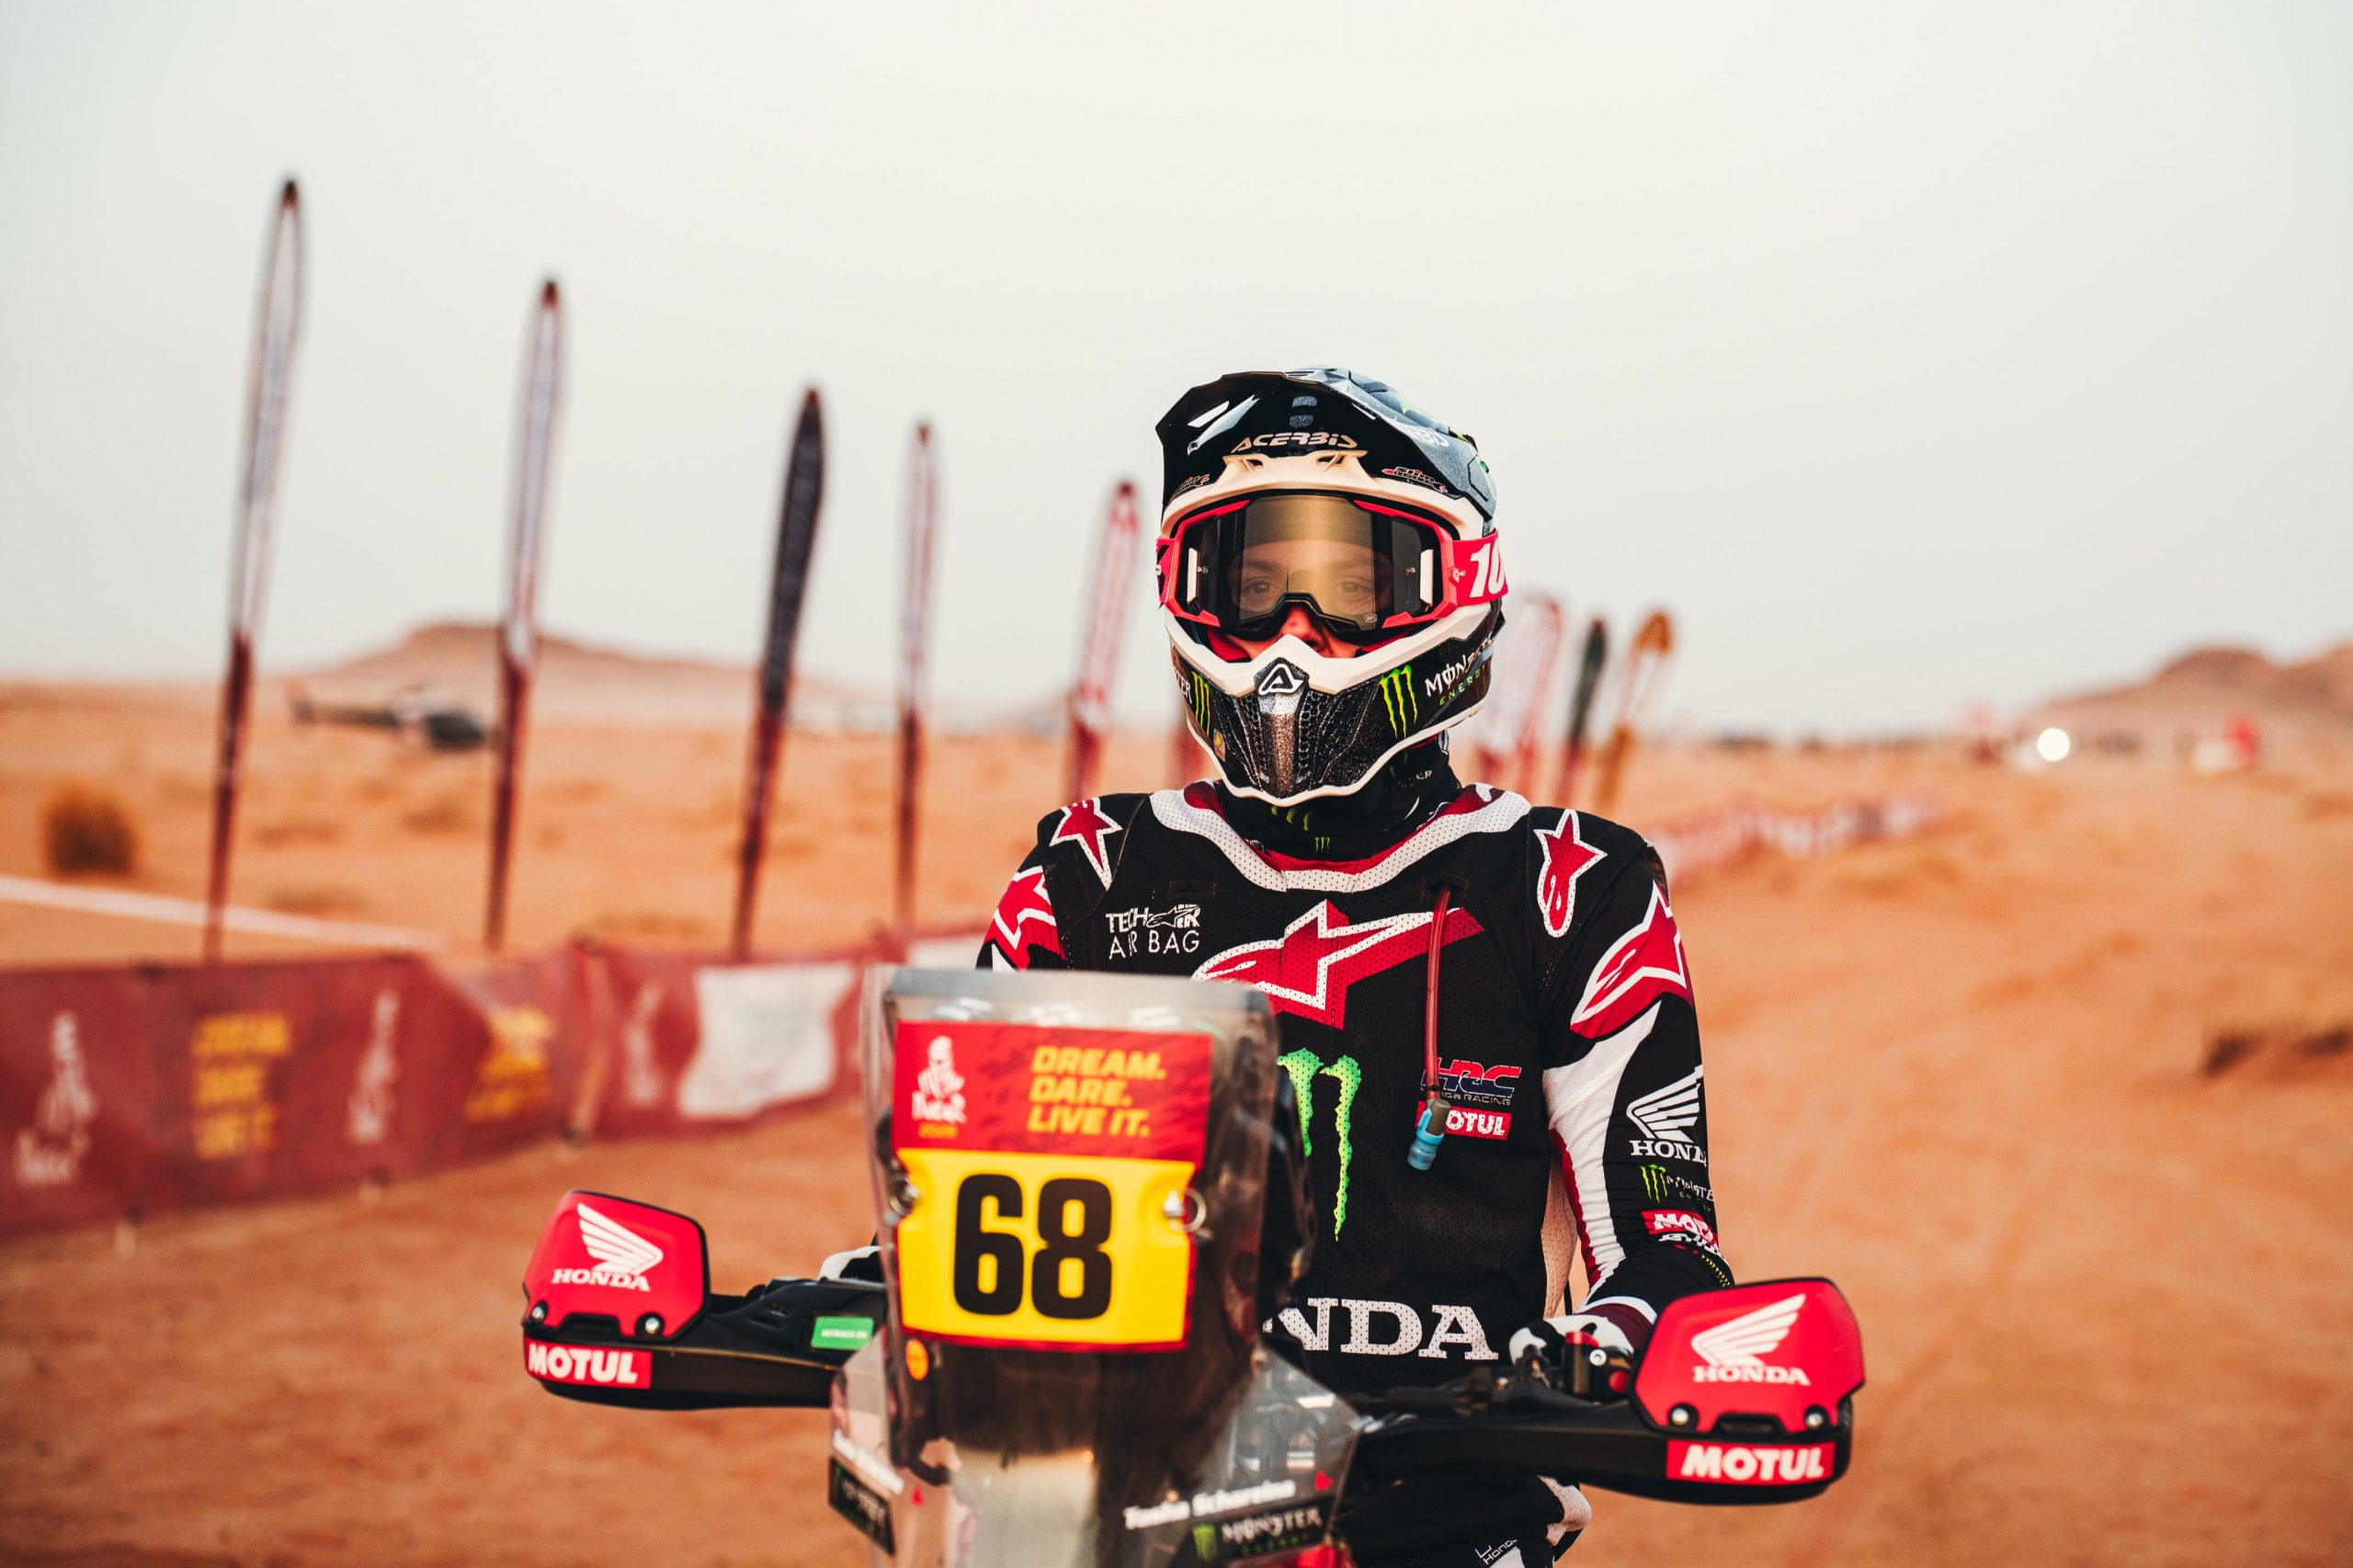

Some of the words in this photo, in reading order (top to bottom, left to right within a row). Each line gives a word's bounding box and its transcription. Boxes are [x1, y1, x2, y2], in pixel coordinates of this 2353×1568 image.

[1231, 431, 1358, 453] ACERBIS
[1031, 1045, 1167, 1080] DREAM.
[1029, 1074, 1133, 1108] DARE.
[1463, 1093, 1511, 1106] RACING
[1027, 1105, 1107, 1135] LIVE
[1108, 1108, 1151, 1139] IT.
[1446, 1109, 1506, 1136] OTUL
[953, 1174, 1112, 1320] 68
[551, 1268, 651, 1292] HONDA
[1263, 1297, 1499, 1360] NDA
[529, 1343, 638, 1384] MOTUL
[1692, 1366, 1811, 1386] HONDA
[1680, 1444, 1824, 1482] MOTUL
